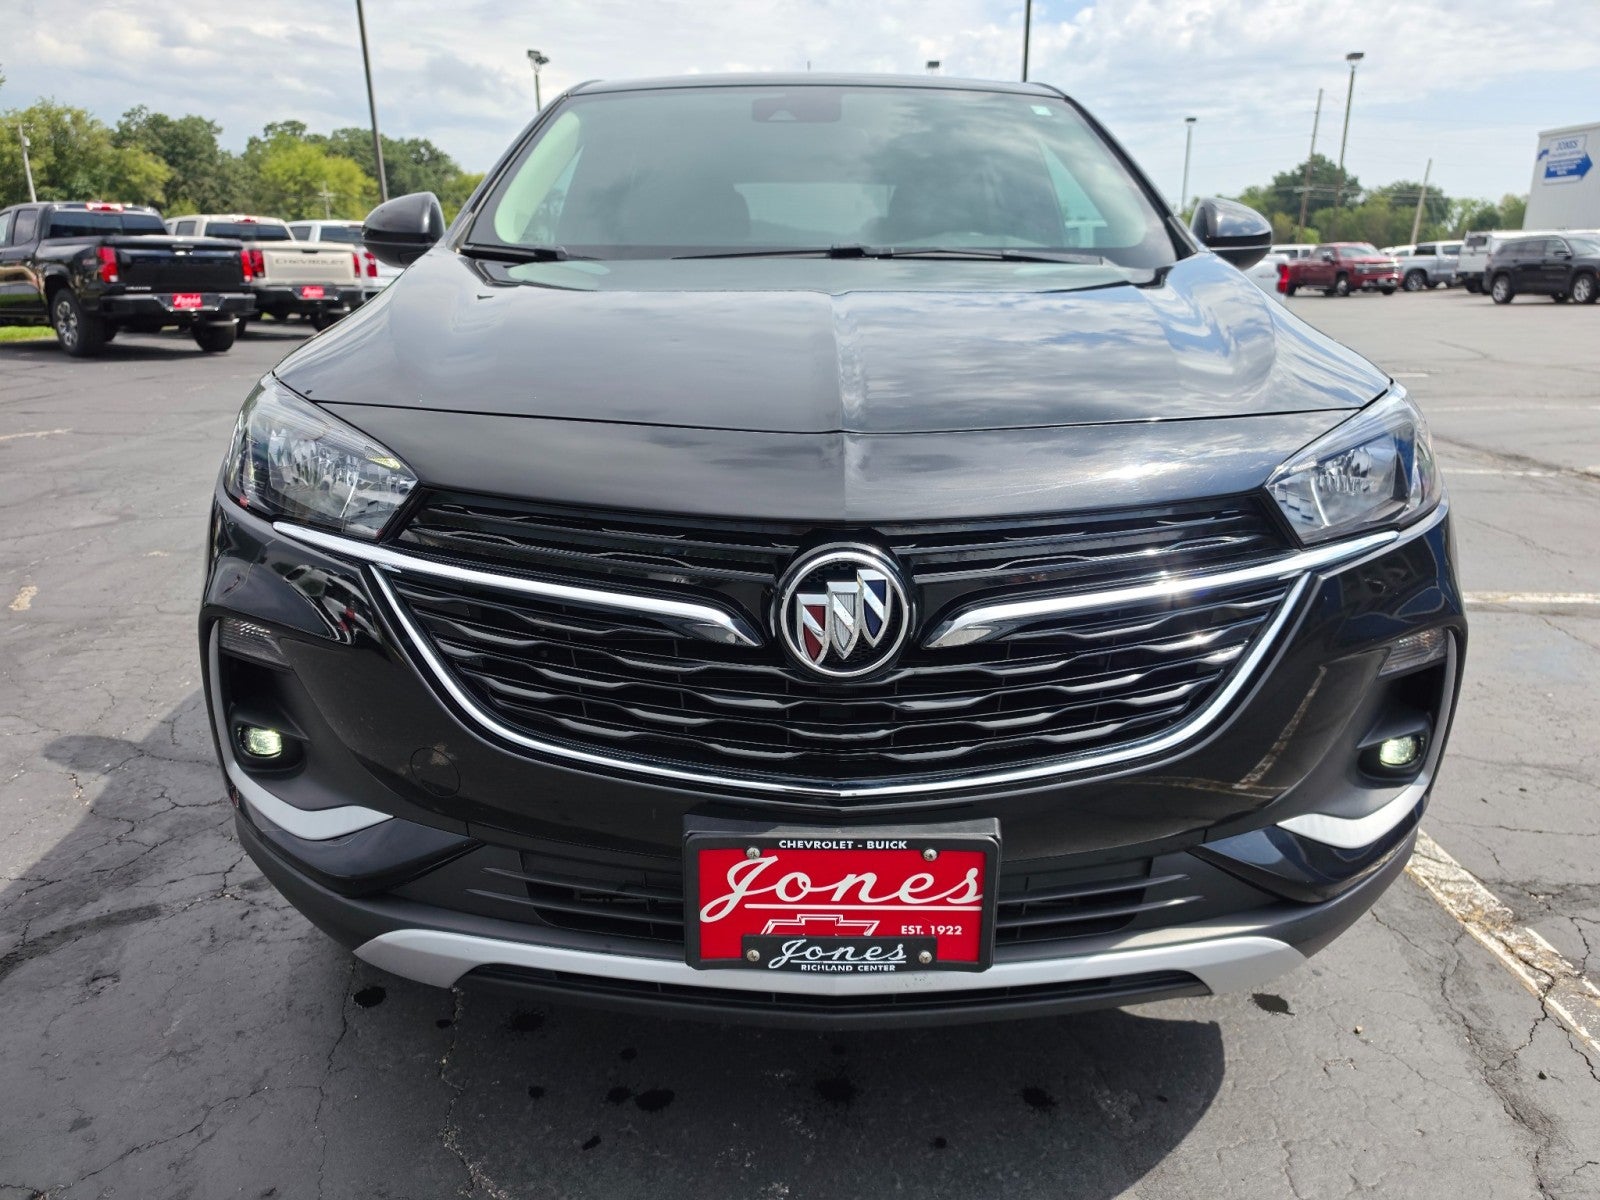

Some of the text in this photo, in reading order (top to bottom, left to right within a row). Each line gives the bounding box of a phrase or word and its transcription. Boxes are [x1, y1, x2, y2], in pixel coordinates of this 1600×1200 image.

[778, 839, 854, 850] CHEVROLET
[866, 839, 908, 850] BUICK
[699, 855, 984, 924] Jones
[900, 924, 963, 936] EST. 1922
[767, 938, 907, 970] Jones
[800, 963, 896, 973] RICHLAND CENTER
